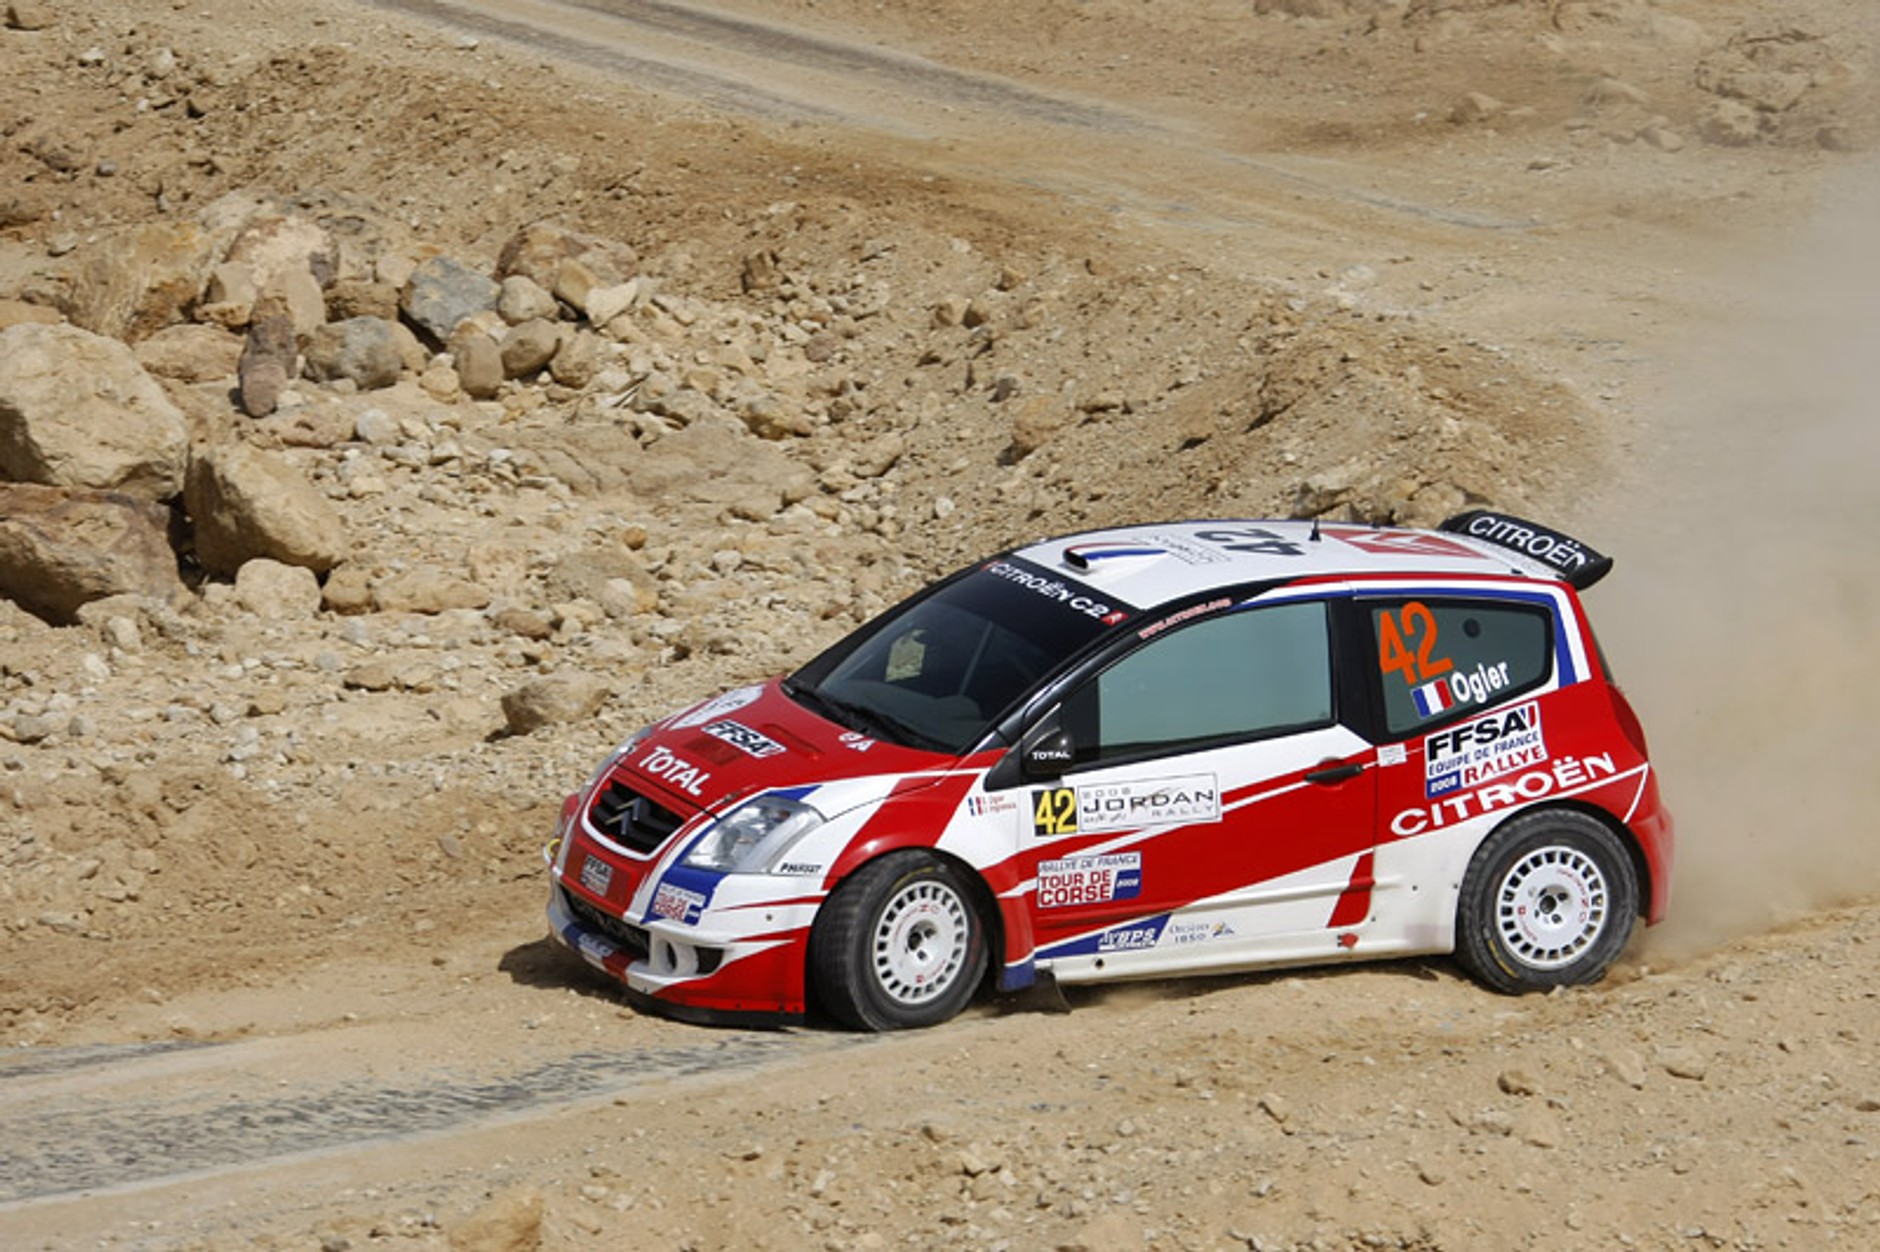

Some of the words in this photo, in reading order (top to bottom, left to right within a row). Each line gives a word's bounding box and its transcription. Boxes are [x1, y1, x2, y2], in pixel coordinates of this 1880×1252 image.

[990, 562, 1075, 602] CITROËN
[1069, 597, 1110, 619] C2
[1379, 601, 1454, 685] 42
[1450, 661, 1511, 704] Ogler
[1032, 749, 1072, 761] TOTAL
[1427, 710, 1528, 762] FFSA
[1428, 753, 1471, 776] EQUIPE
[1474, 747, 1490, 761] DE
[1494, 731, 1540, 755] FRANCE
[639, 745, 711, 796] TOTAL
[1464, 745, 1545, 785] RALLYE
[1034, 789, 1077, 834] 42
[1082, 789, 1214, 814] JORDAN
[1151, 804, 1213, 817] RALLY
[1390, 751, 1617, 836] CITROËN
[1040, 873, 1085, 889] TOUR
[1090, 868, 1112, 885] DE
[1098, 854, 1138, 866] FRANCE
[1040, 882, 1111, 906] CORSE
